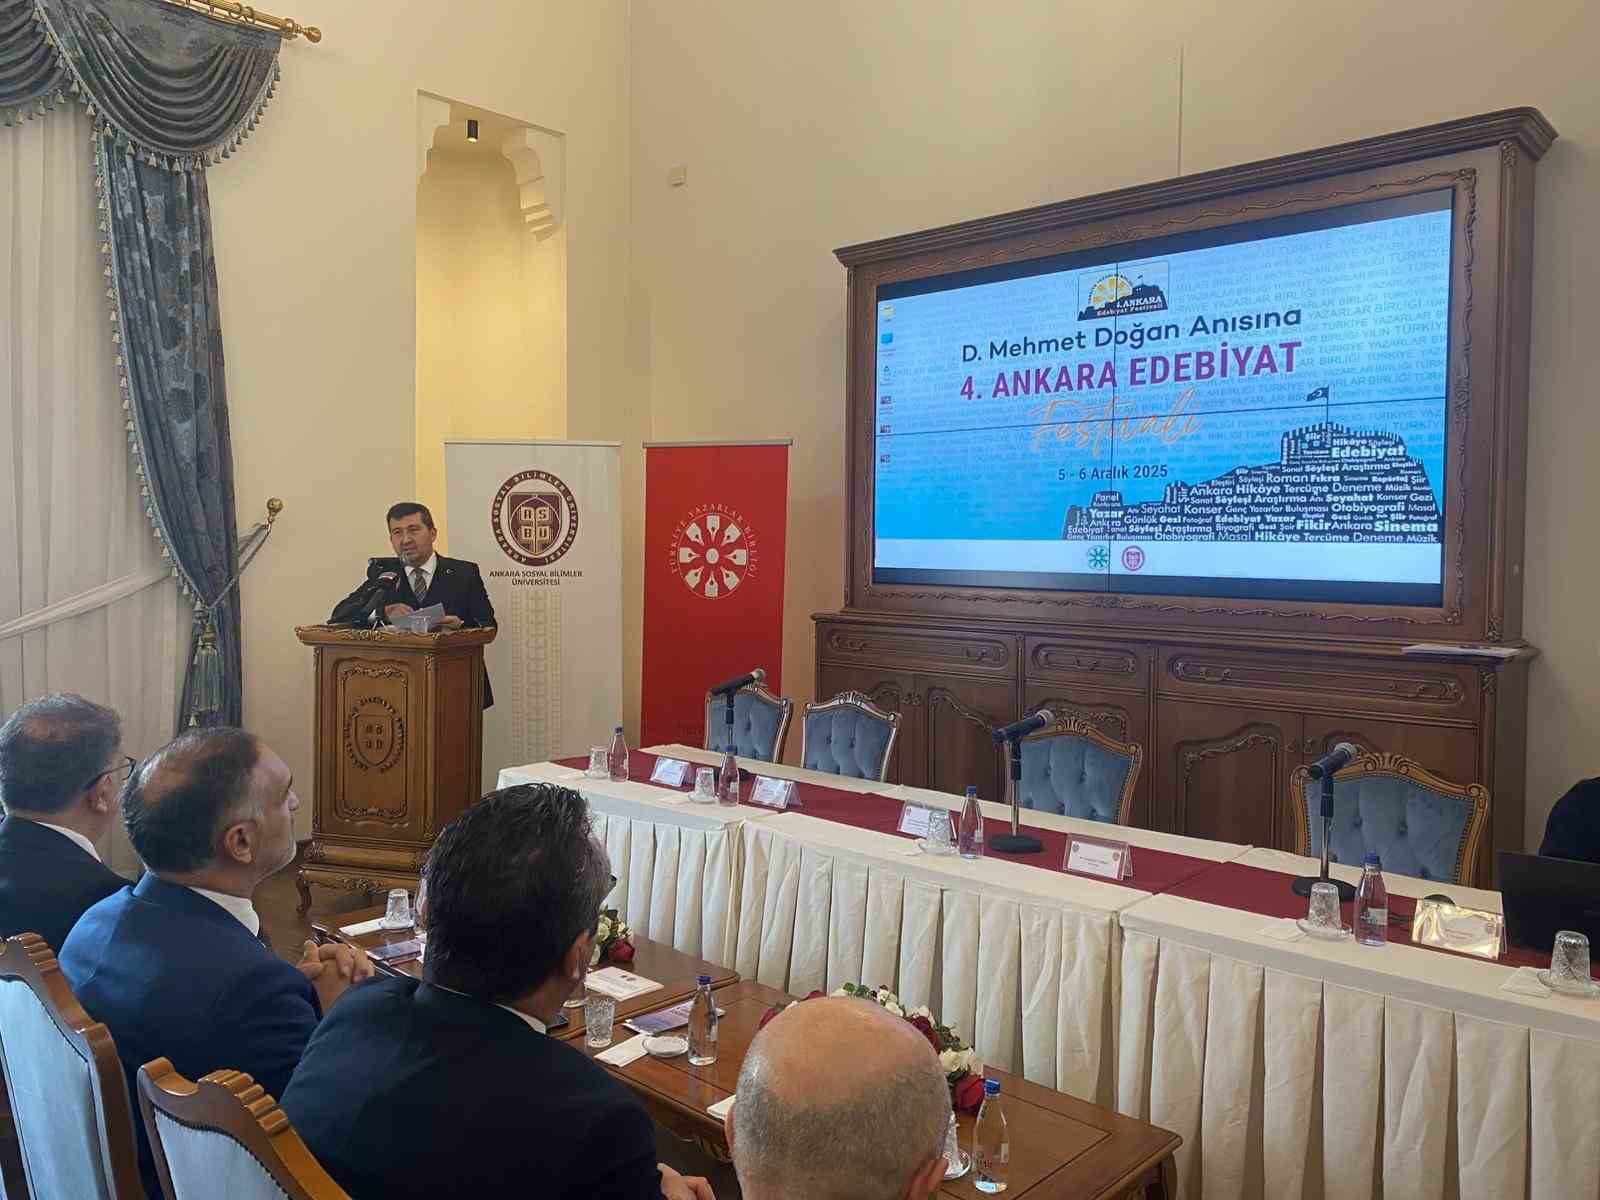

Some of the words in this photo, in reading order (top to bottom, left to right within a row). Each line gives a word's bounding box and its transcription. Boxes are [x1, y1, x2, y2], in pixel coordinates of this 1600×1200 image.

[963, 345, 981, 362] D.
[990, 331, 1086, 359] Mehmet
[1095, 323, 1180, 349] Doğan
[1189, 309, 1302, 336] Anısına
[960, 376, 982, 400] 4.
[992, 361, 1118, 397] ANKARA
[1130, 341, 1302, 386] EDEBİYAT
[1331, 445, 1406, 459] Edebiyat
[1058, 469, 1065, 480] 5
[1079, 468, 1086, 480] 6
[1091, 466, 1128, 480] Aralık
[1133, 465, 1168, 479] 2025
[1266, 473, 1308, 483] Roman
[1190, 486, 1232, 496] Ankara
[1332, 482, 1382, 493] Deneme
[1325, 493, 1374, 504] Seyahat
[1409, 493, 1433, 502] Gezi
[1089, 508, 1124, 519] Yazar
[1141, 503, 1180, 514] Seyahat
[1184, 504, 1222, 514] Konser
[1331, 502, 1405, 513] Otobiyografi
[1160, 515, 1181, 524] Gezi
[1215, 514, 1261, 523] Edebiyat
[1296, 518, 1331, 530] Fikir
[1331, 521, 1373, 530] Ankara
[1374, 520, 1439, 532] Sinema
[1303, 532, 1349, 542] Tercüme
[1353, 532, 1404, 542] Deneme
[550, 568, 583, 577] BİLİMLER
[512, 577, 560, 586] ÜNİVERSİTESİ
